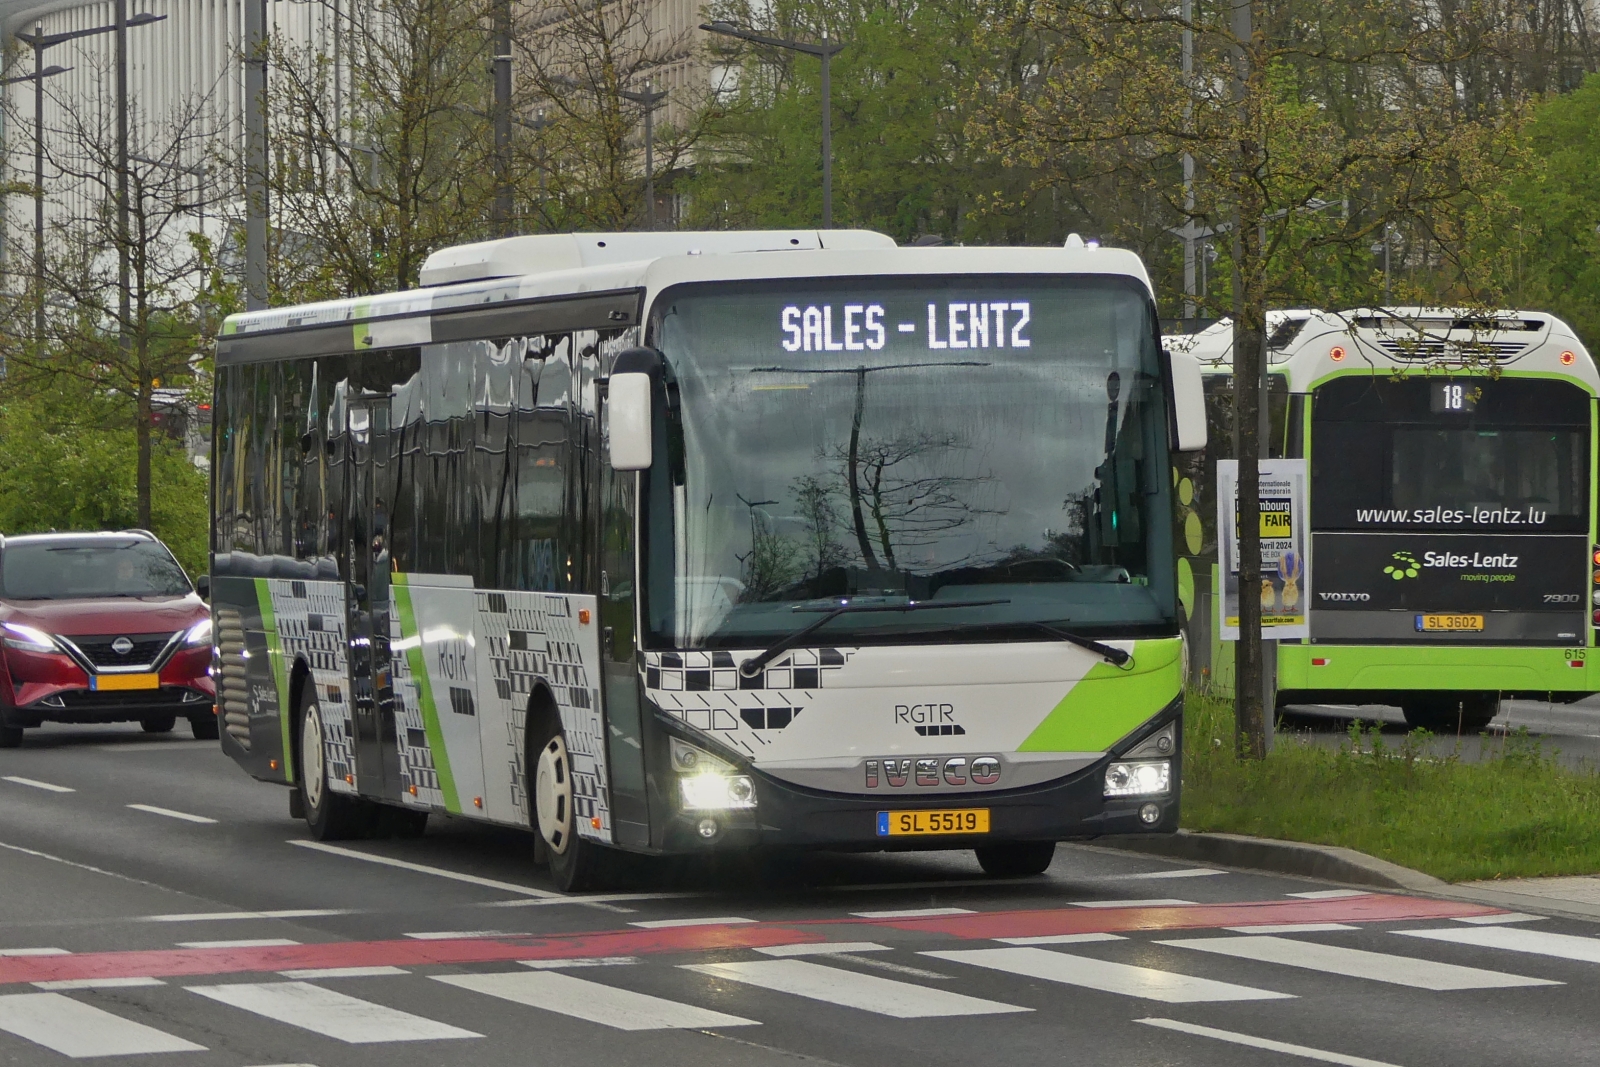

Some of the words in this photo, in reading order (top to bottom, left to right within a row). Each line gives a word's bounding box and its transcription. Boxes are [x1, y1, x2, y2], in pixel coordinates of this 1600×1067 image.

[781, 303, 885, 352] SALES
[927, 301, 1031, 350] LENTZ
[1442, 385, 1463, 409] 18
[1264, 514, 1291, 527] FAIR
[1356, 505, 1547, 525] www.sales-lentz.lu
[1260, 541, 1275, 550] Avril
[1275, 541, 1292, 550] 2024
[1423, 551, 1519, 569] Sales-Lentz
[1460, 573, 1489, 584] moving
[1489, 573, 1516, 584] people
[1318, 592, 1371, 602] VOLVO
[1543, 594, 1580, 603] 7900
[1429, 616, 1444, 628] SL
[1446, 616, 1477, 628] 3602
[1564, 648, 1586, 659] 615
[895, 703, 955, 724] RGTR
[865, 756, 1002, 789] IVECO
[900, 814, 924, 832] SL
[929, 812, 977, 832] 5519
